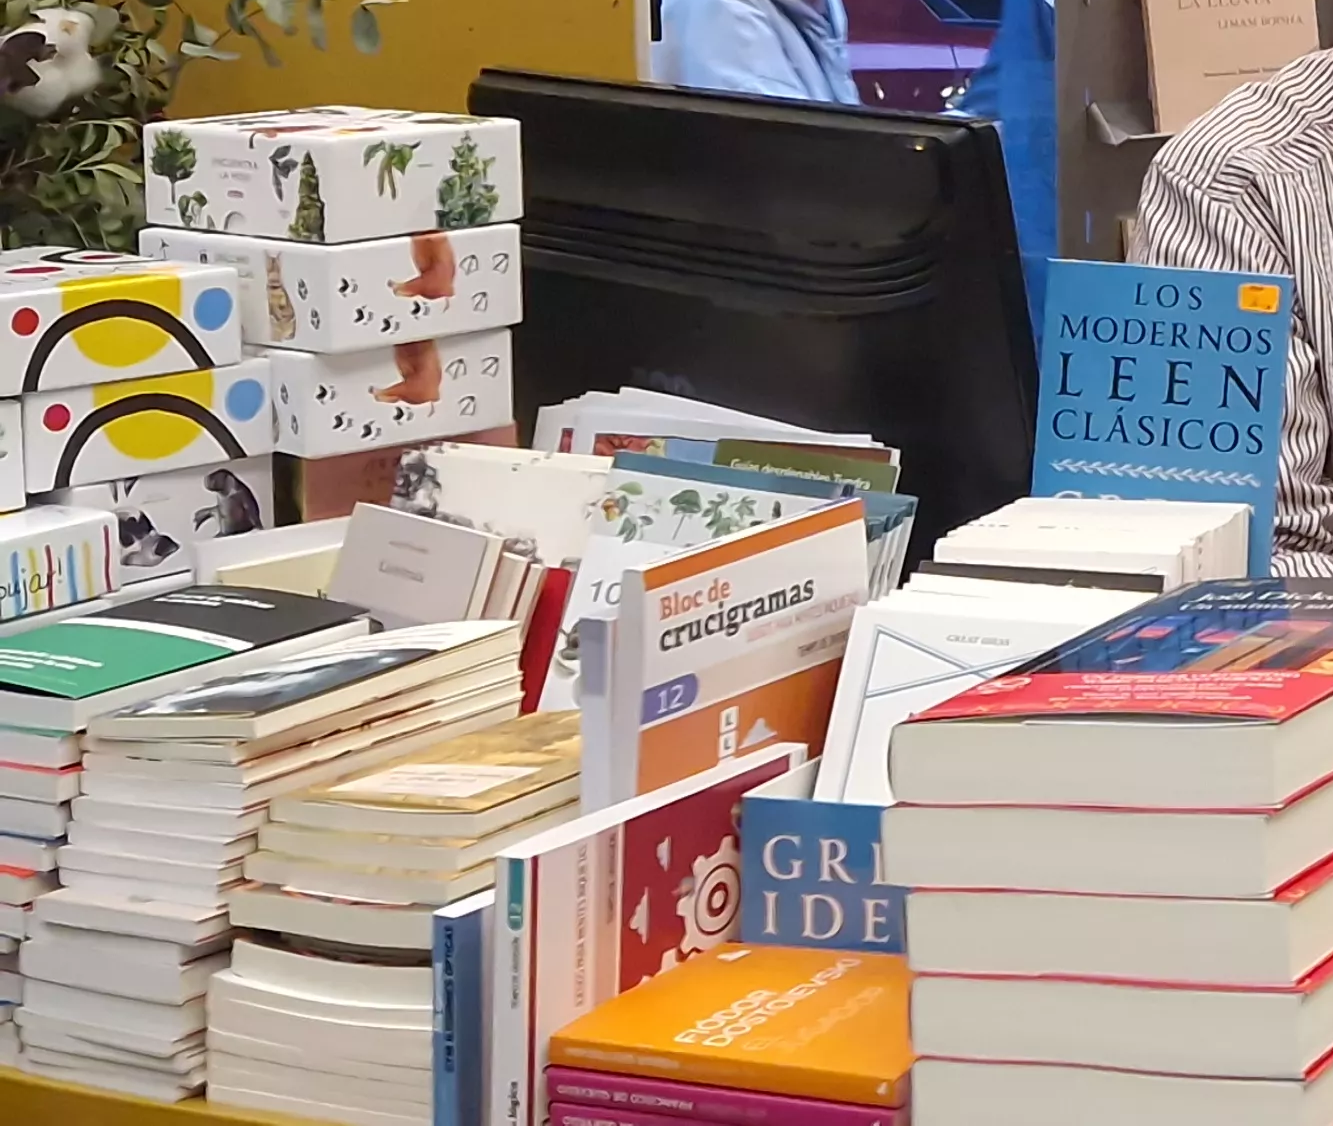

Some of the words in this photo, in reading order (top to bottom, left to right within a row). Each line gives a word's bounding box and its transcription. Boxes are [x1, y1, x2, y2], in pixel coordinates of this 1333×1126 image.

[1134, 282, 1204, 311] LOS
[1059, 314, 1273, 356] MODERNOS
[1056, 351, 1269, 413] LEEN
[1052, 406, 1264, 455] CLÁSICOS
[658, 587, 704, 621] Bloc
[707, 576, 732, 601] de
[658, 576, 815, 652] crucigramas
[656, 684, 685, 715] 12
